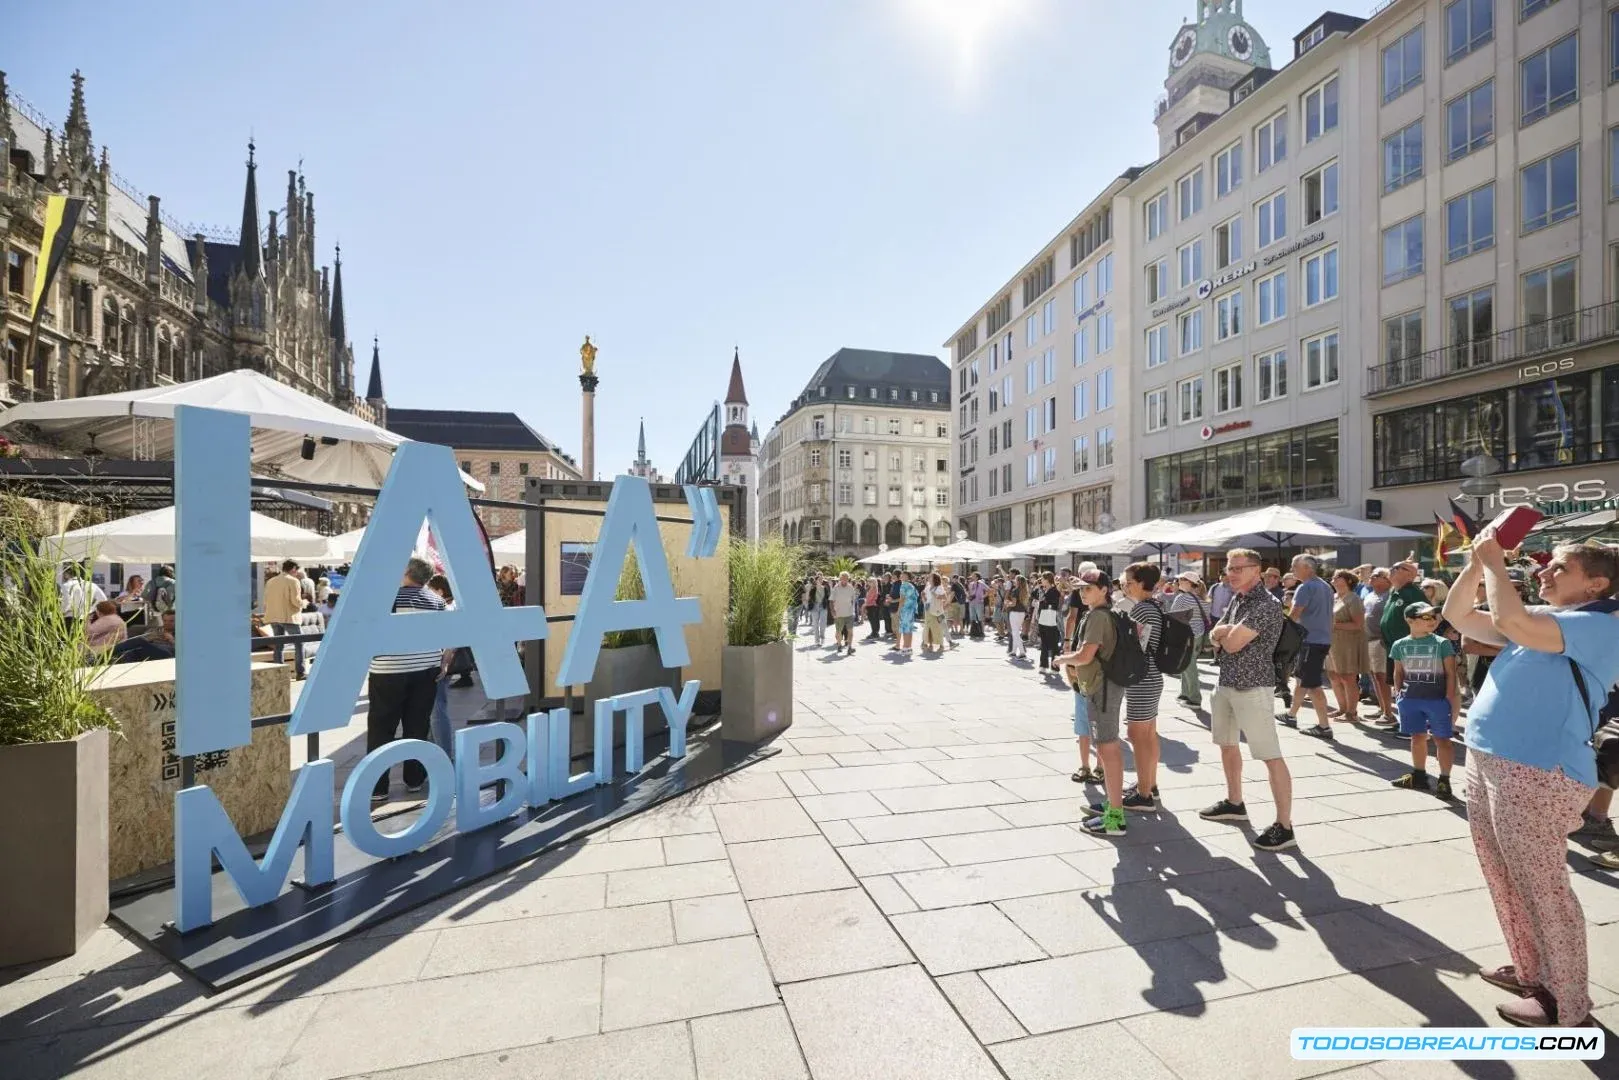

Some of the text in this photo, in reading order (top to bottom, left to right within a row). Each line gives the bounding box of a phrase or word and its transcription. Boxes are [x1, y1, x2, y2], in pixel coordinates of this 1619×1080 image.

[1213, 261, 1257, 289] KERN
[1518, 357, 1576, 379] IQOS
[175, 404, 701, 758] IAA
[175, 680, 702, 934] MOBILITY
